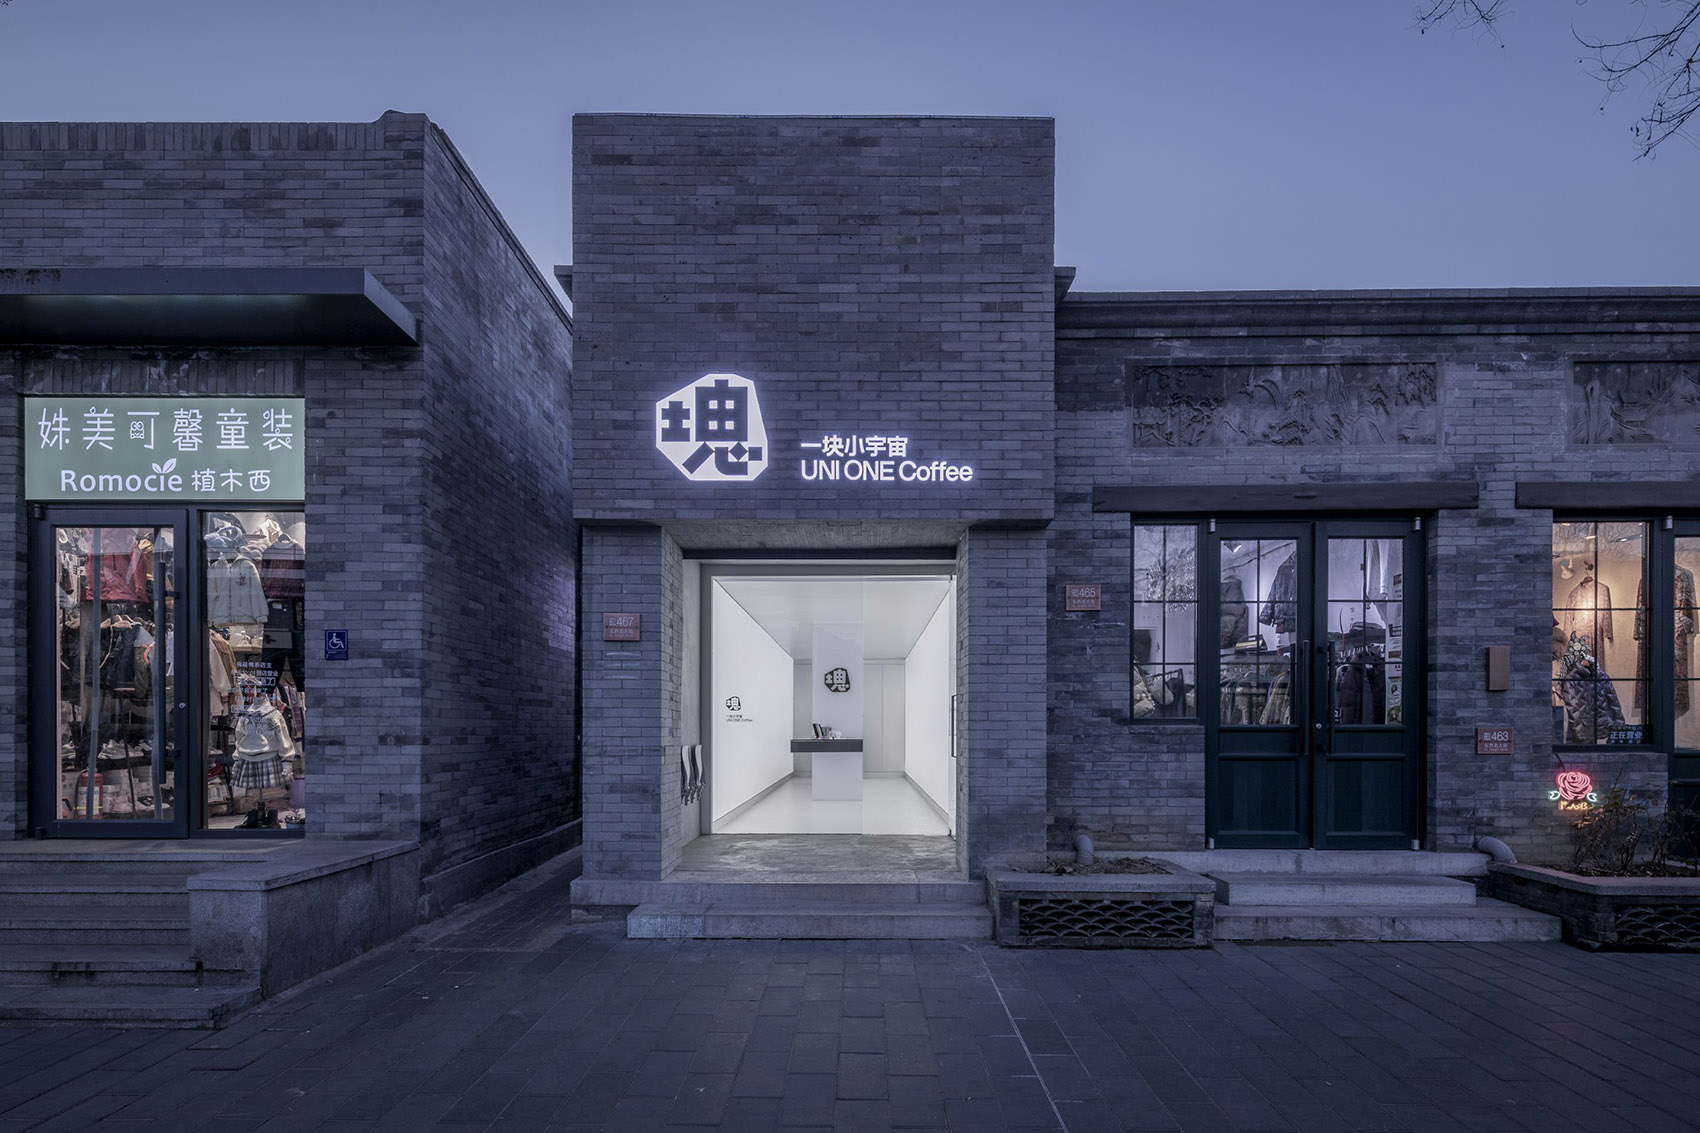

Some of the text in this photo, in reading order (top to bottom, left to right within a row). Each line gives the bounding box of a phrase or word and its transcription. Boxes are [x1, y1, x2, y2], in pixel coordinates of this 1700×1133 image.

[38, 407, 293, 451] 姝美可馨童装
[800, 435, 908, 458] 一块小宇宙
[60, 469, 183, 492] Romocie
[191, 468, 271, 493] 植木西
[801, 460, 973, 482] UNI ONE Coffee
[1078, 588, 1096, 597] 465
[616, 616, 634, 626] 467
[1491, 731, 1509, 741] 463
